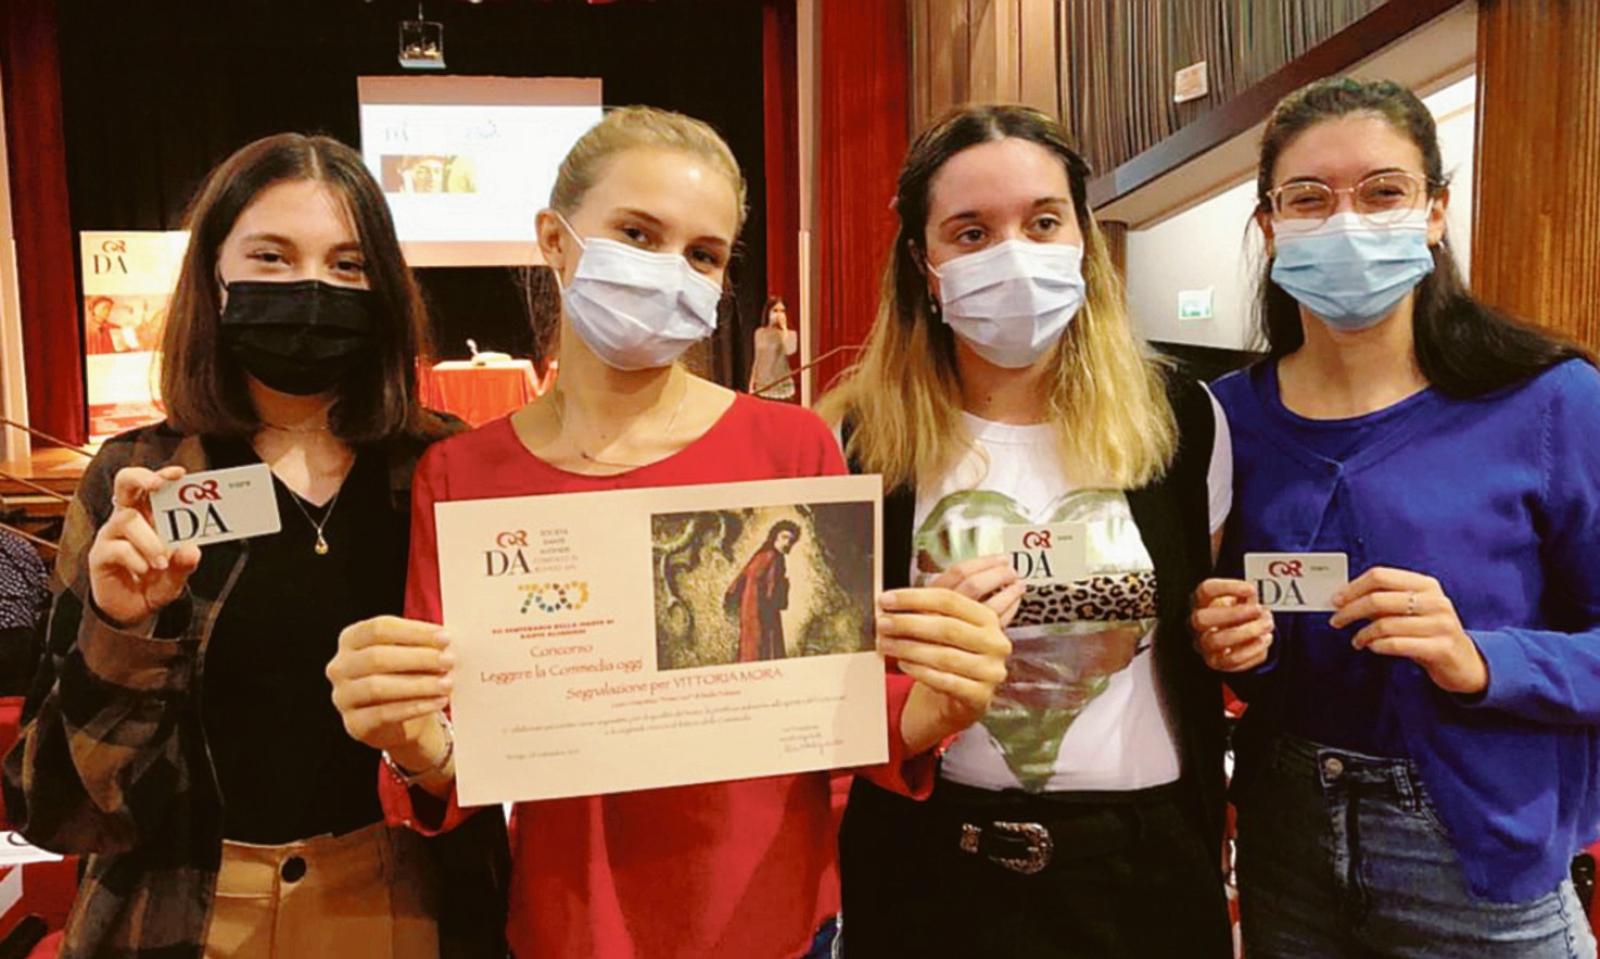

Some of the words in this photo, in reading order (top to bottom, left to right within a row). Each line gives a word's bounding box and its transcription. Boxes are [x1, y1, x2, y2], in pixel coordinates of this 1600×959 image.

[93, 253, 128, 275] DA
[162, 502, 234, 543] DA
[484, 548, 531, 576] DA
[1010, 549, 1054, 579] DA
[1253, 578, 1307, 605] DA
[529, 643, 594, 658] Concorso
[480, 669, 533, 685] Leggere
[535, 663, 547, 678] la
[549, 658, 614, 677] Commedia
[616, 658, 643, 673] oggi
[565, 682, 647, 701] Segnalazione
[650, 680, 670, 695] per
[673, 672, 738, 689] VITTORIA
[738, 667, 783, 683] MORA
